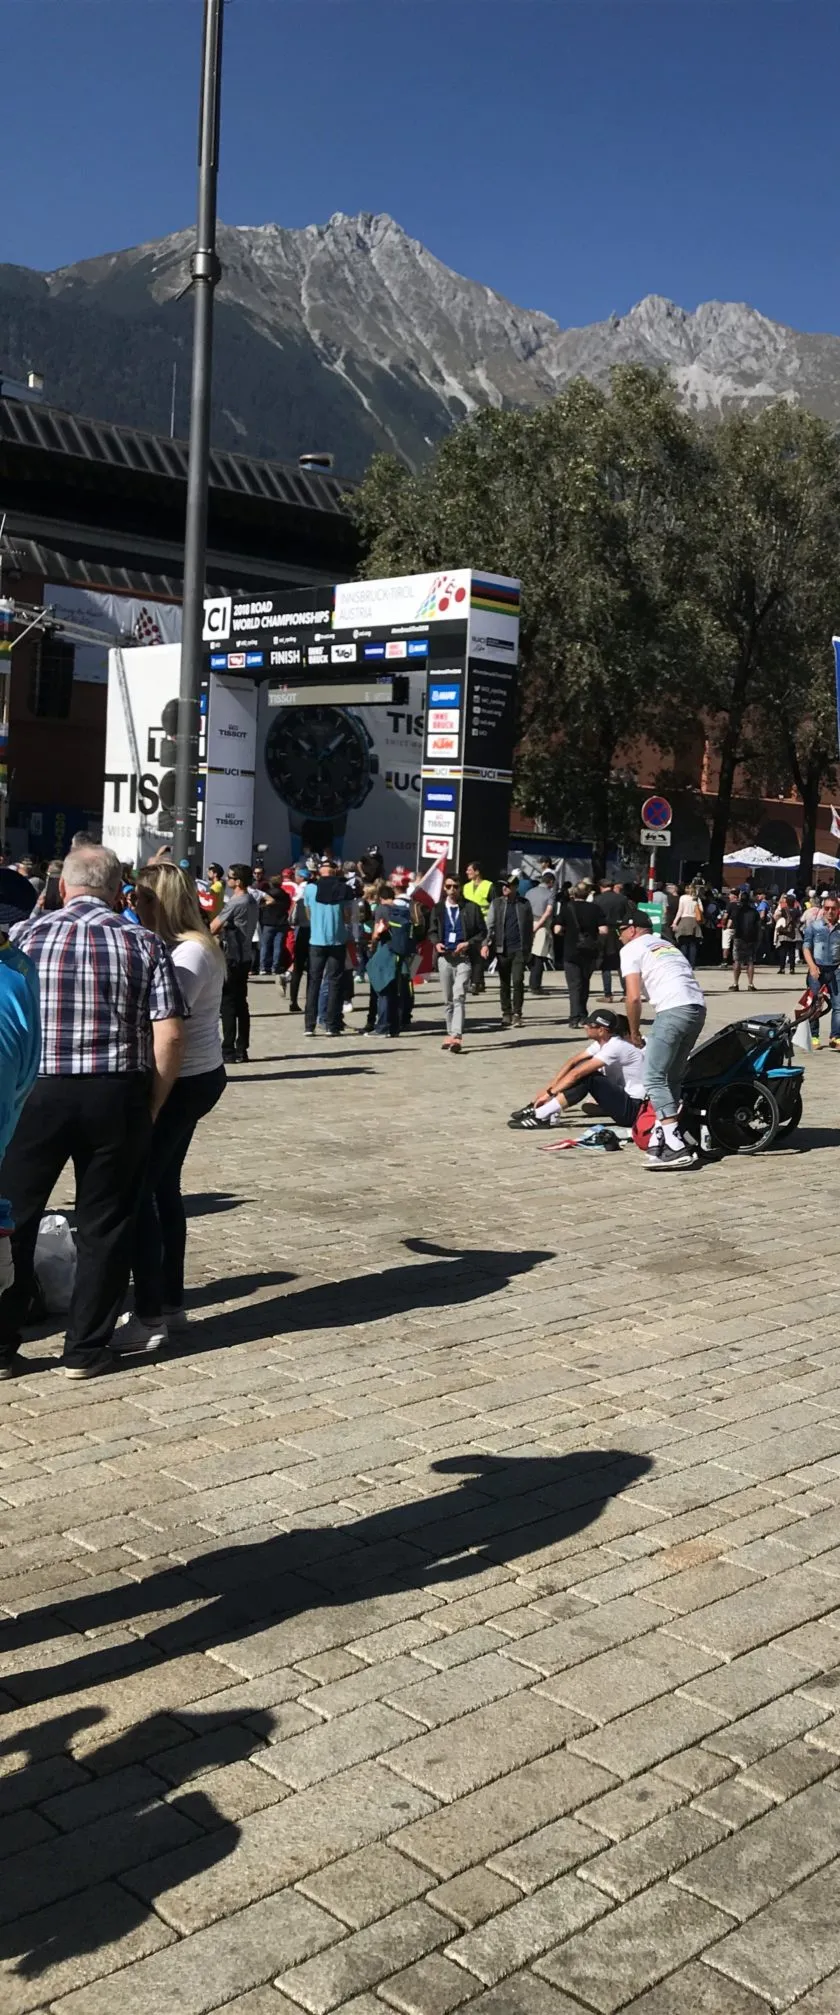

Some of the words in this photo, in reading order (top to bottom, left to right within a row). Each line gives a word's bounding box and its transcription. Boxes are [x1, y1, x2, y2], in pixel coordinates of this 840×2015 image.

[341, 586, 415, 604] INNSBRUCK-TIROL
[233, 603, 250, 616] 2018
[250, 601, 273, 614] ROAD
[340, 606, 372, 620] AUSTRIA
[207, 607, 227, 632] CI
[232, 616, 260, 631] WORLD
[261, 610, 330, 628] CHAMPIONSHIPS
[270, 650, 300, 665] FINISH
[268, 692, 297, 704] TISSOT
[218, 728, 247, 739] TISSOT
[224, 767, 240, 777] UCI
[435, 766, 448, 776] UCI
[480, 770, 496, 779] UCI
[394, 772, 420, 792] UC
[104, 773, 159, 815] TIS
[215, 817, 245, 827] TISSOT
[427, 820, 451, 828] TISSOT
[107, 825, 132, 838] WISS
[385, 841, 418, 851] TISSOT
